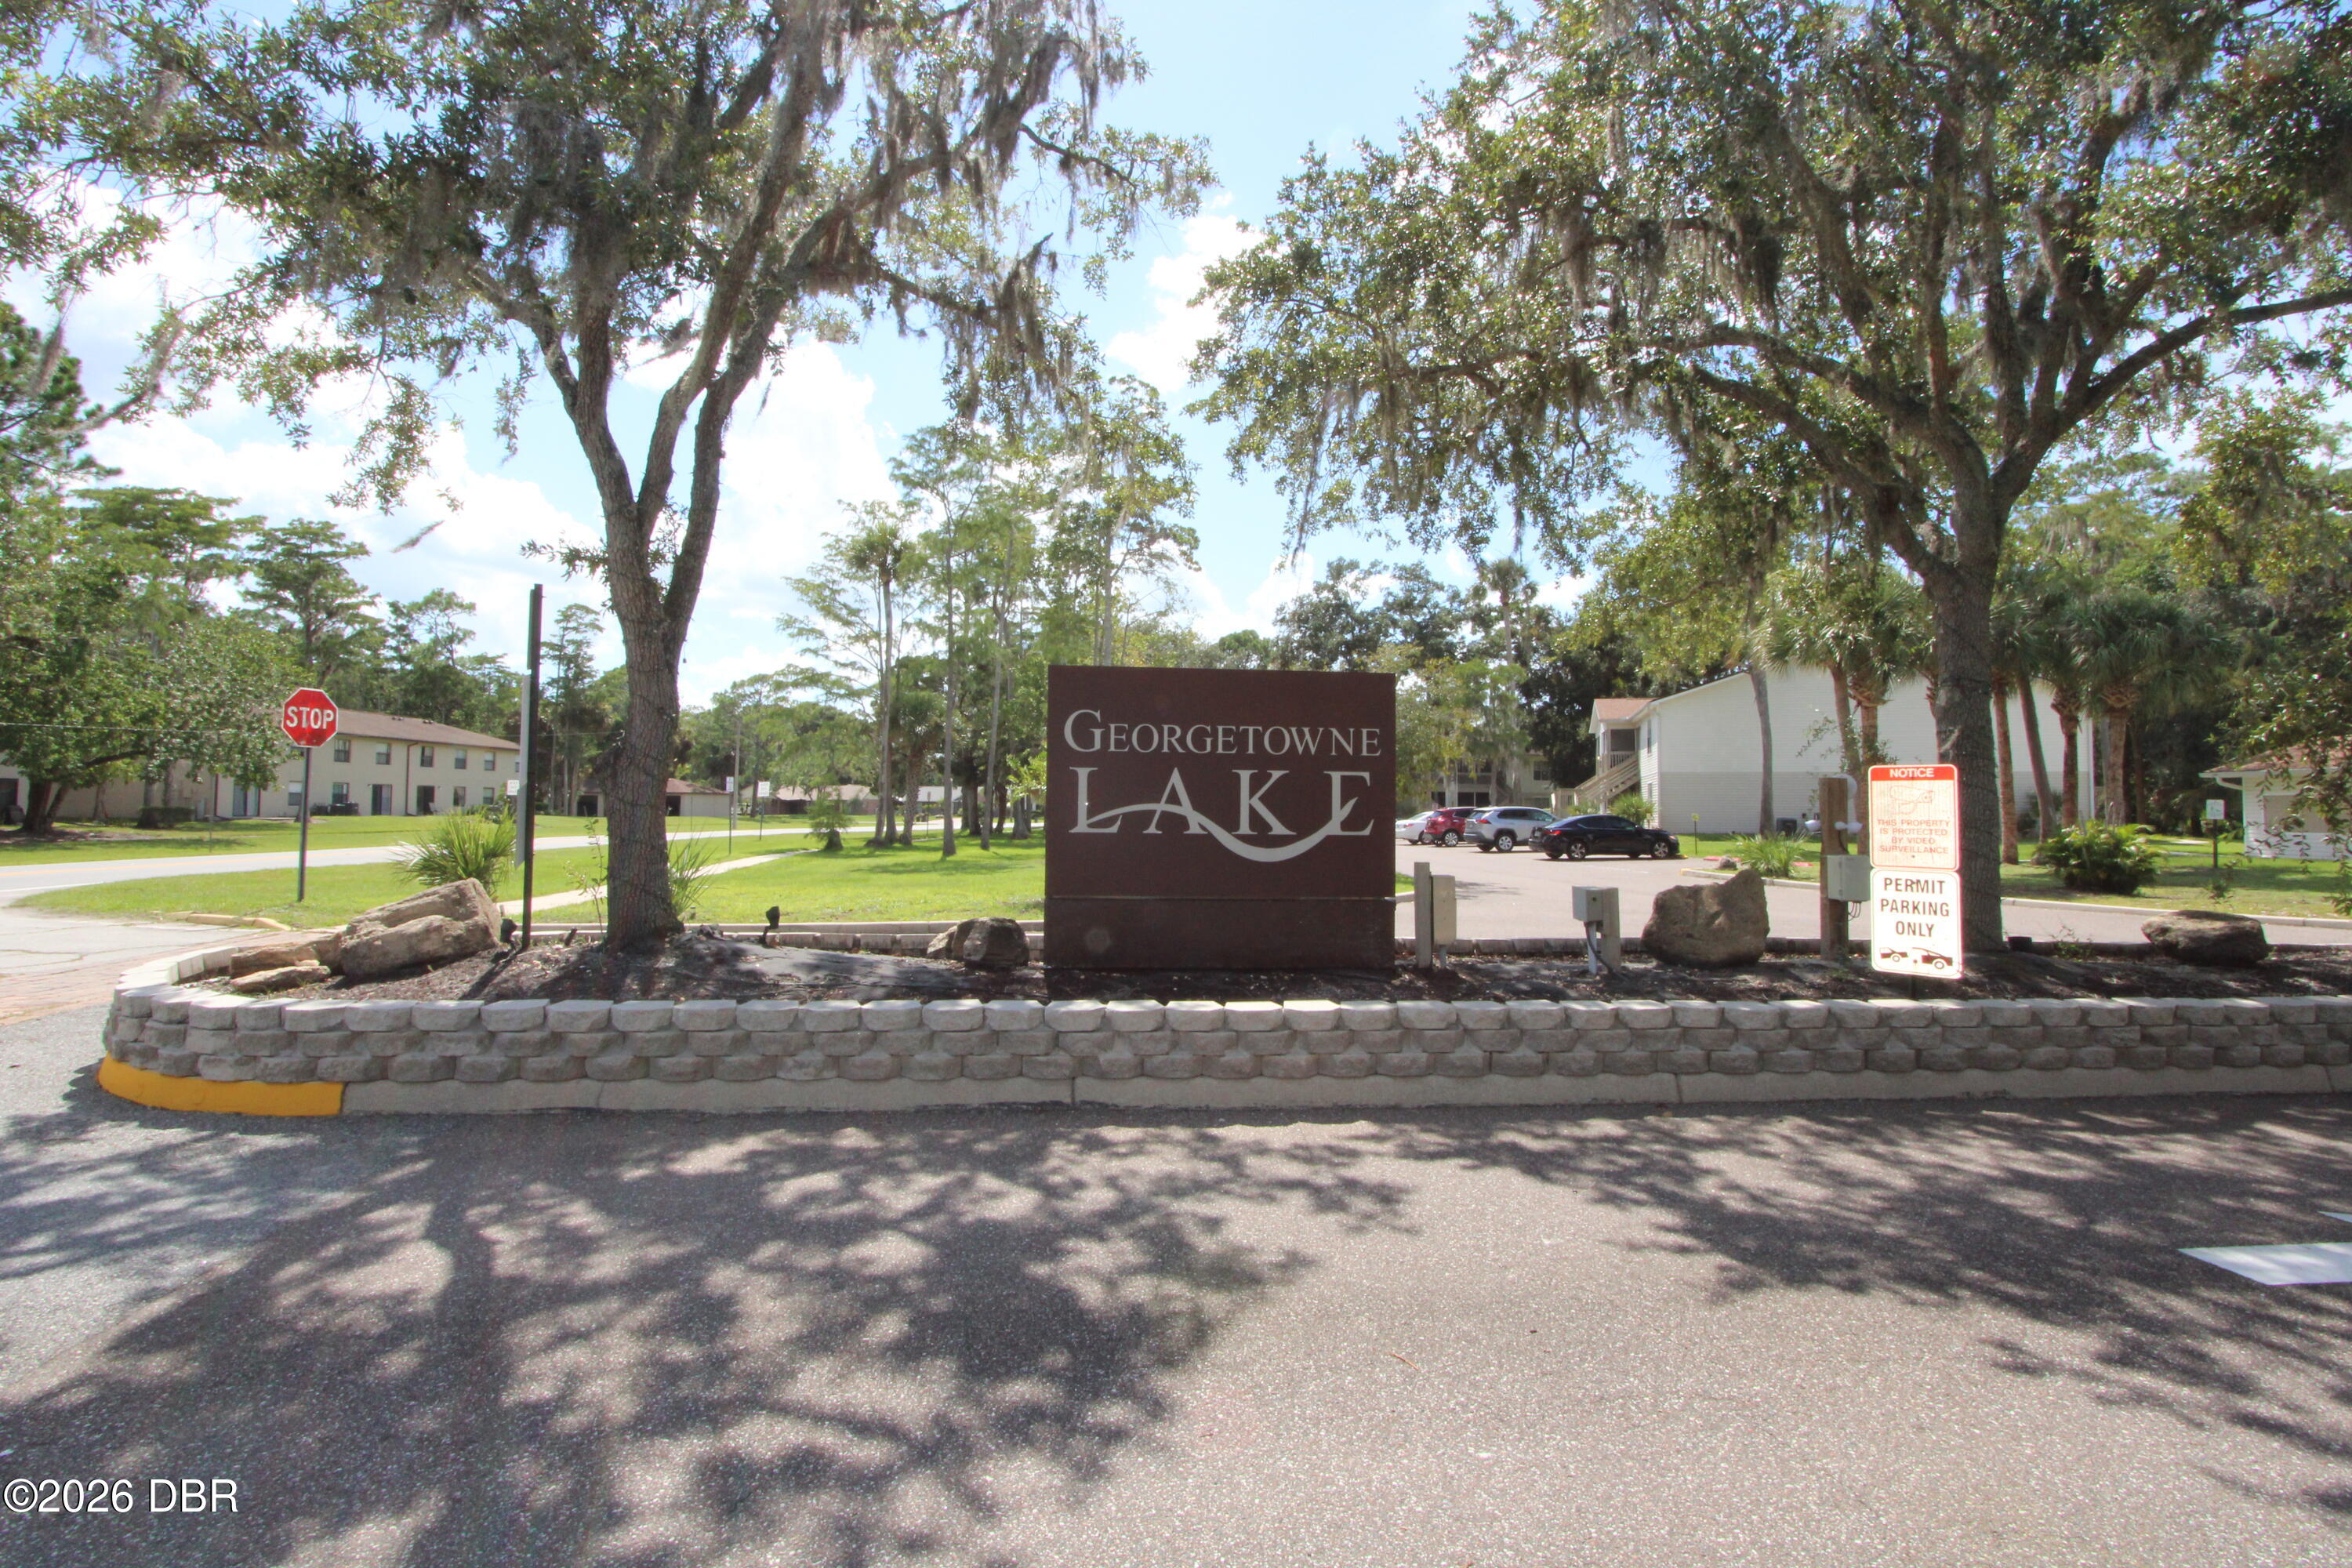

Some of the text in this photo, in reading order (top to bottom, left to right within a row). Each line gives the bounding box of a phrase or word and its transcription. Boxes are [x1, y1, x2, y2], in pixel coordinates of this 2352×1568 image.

[286, 706, 334, 729] STOP
[1064, 710, 1381, 757] GEORGETOWNE
[1889, 768, 1935, 778] NOTICE
[1069, 767, 1374, 837] LAKE
[1879, 845, 1949, 854] SURVEILLANCE
[1883, 877, 1945, 894] PERMIT
[1880, 898, 1950, 916] PARKING
[1896, 920, 1935, 937] ONLY
